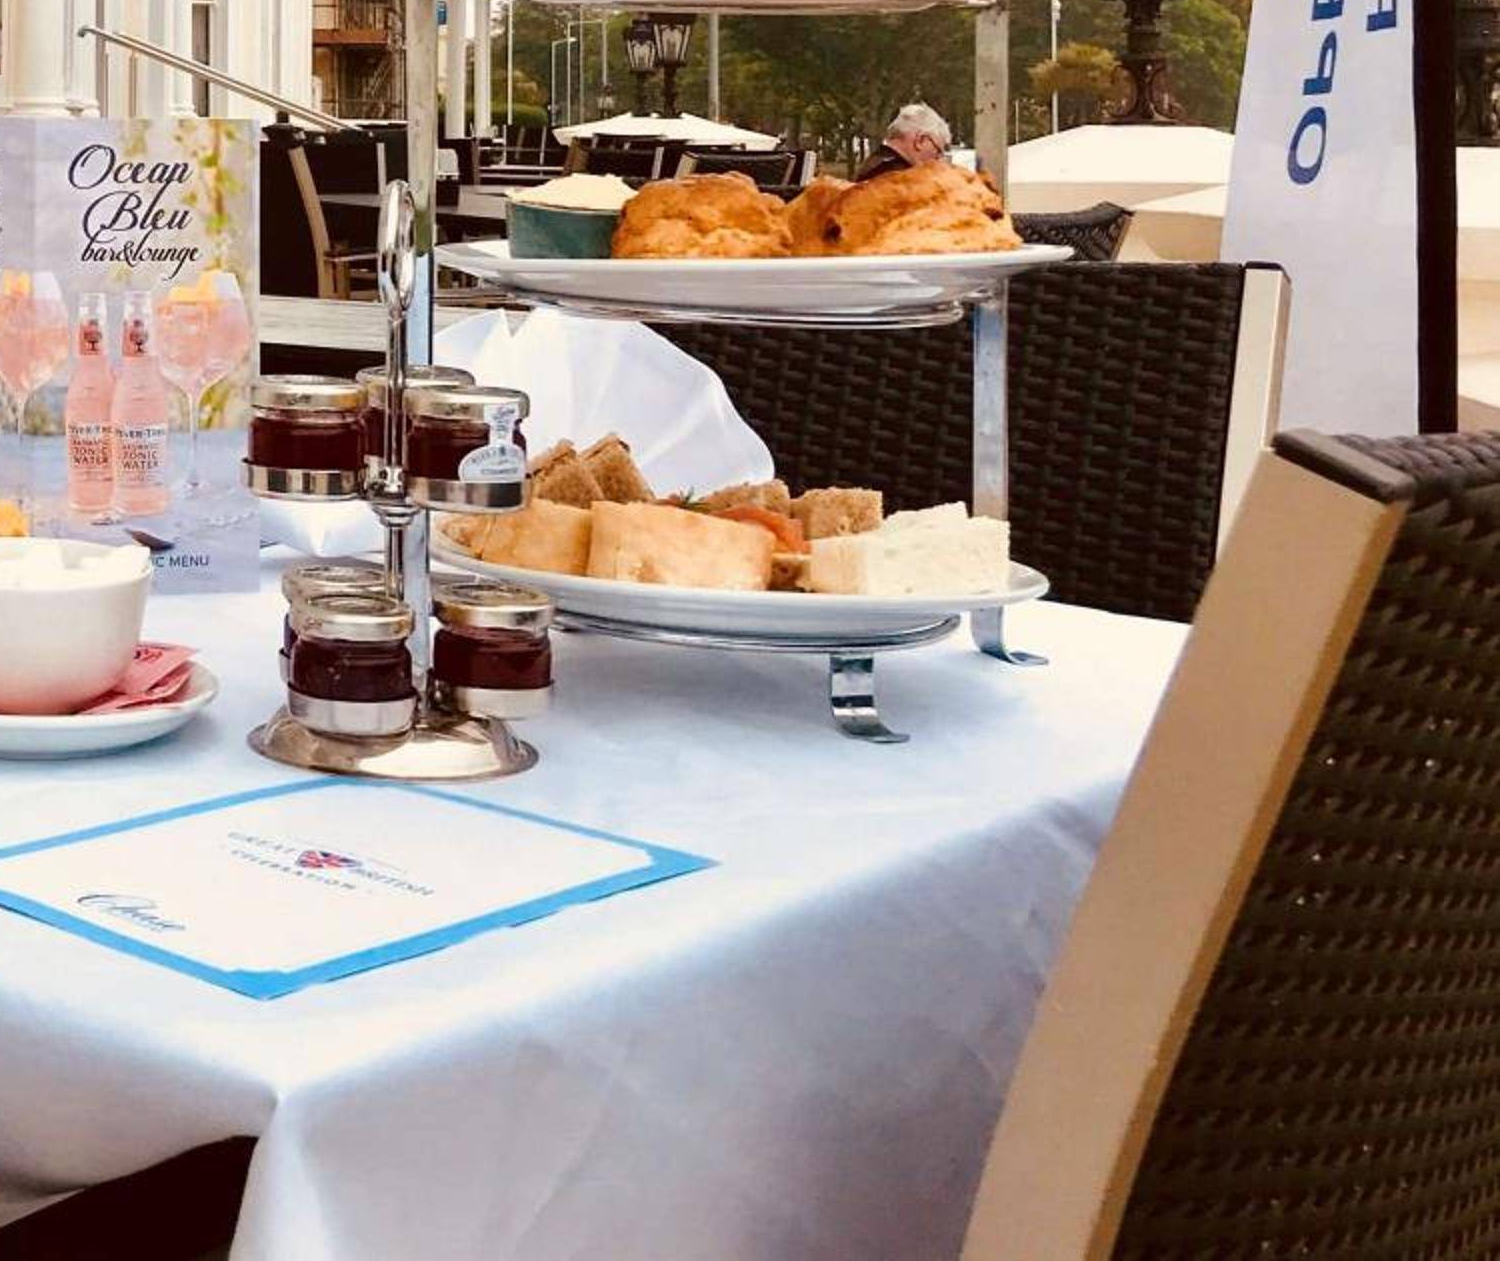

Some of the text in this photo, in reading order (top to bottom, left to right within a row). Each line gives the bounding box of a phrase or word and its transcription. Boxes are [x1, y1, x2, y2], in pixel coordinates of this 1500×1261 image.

[67, 144, 193, 191] Ocean
[82, 180, 193, 244] Bleu
[73, 456, 110, 466] WATER
[123, 450, 159, 460] TONIC
[122, 460, 160, 471] WATER
[168, 555, 210, 568] MENU
